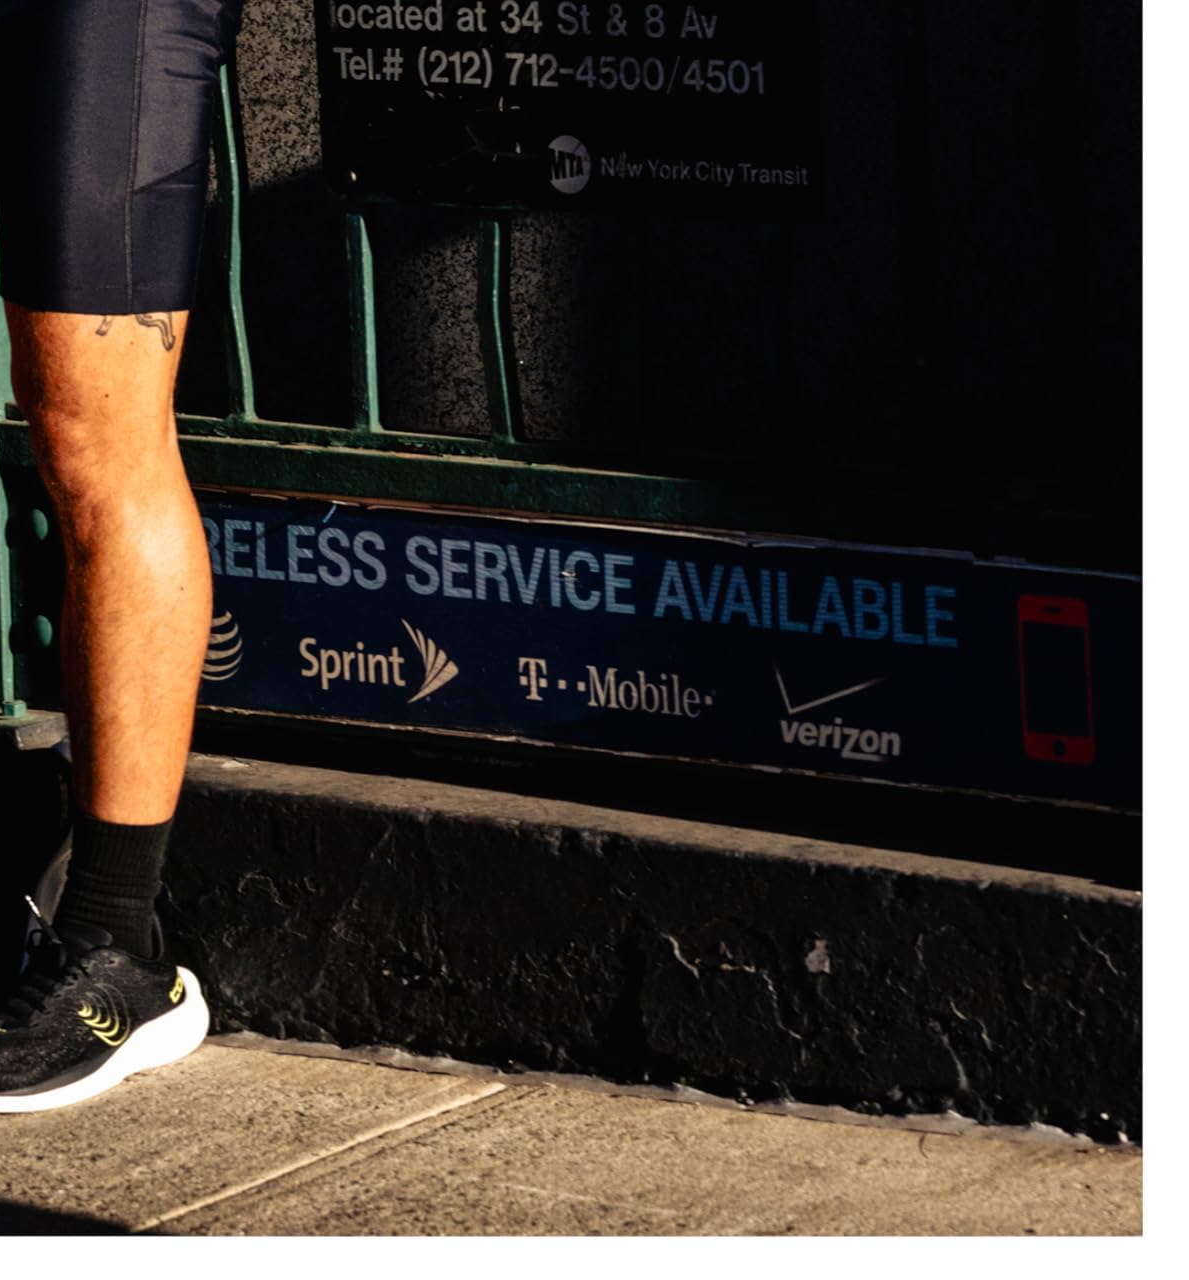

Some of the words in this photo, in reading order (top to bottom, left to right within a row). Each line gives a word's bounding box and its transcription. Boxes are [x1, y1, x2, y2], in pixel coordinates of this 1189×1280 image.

[456, 0, 488, 34] at
[499, 0, 544, 35] 34
[556, 2, 592, 36] St
[606, 4, 629, 37] &
[644, 3, 666, 38] 8
[680, 5, 718, 40] Av
[332, 46, 405, 82] Tel.#
[417, 45, 493, 89] (212)
[504, 51, 765, 95] 712-4500/4501
[646, 159, 691, 183] York
[695, 160, 735, 188] City
[738, 162, 811, 185] Transit
[404, 534, 637, 617] SERVICE
[652, 558, 959, 649] AVAILABLE
[299, 637, 407, 691] Sprint
[779, 716, 902, 763] verizon
